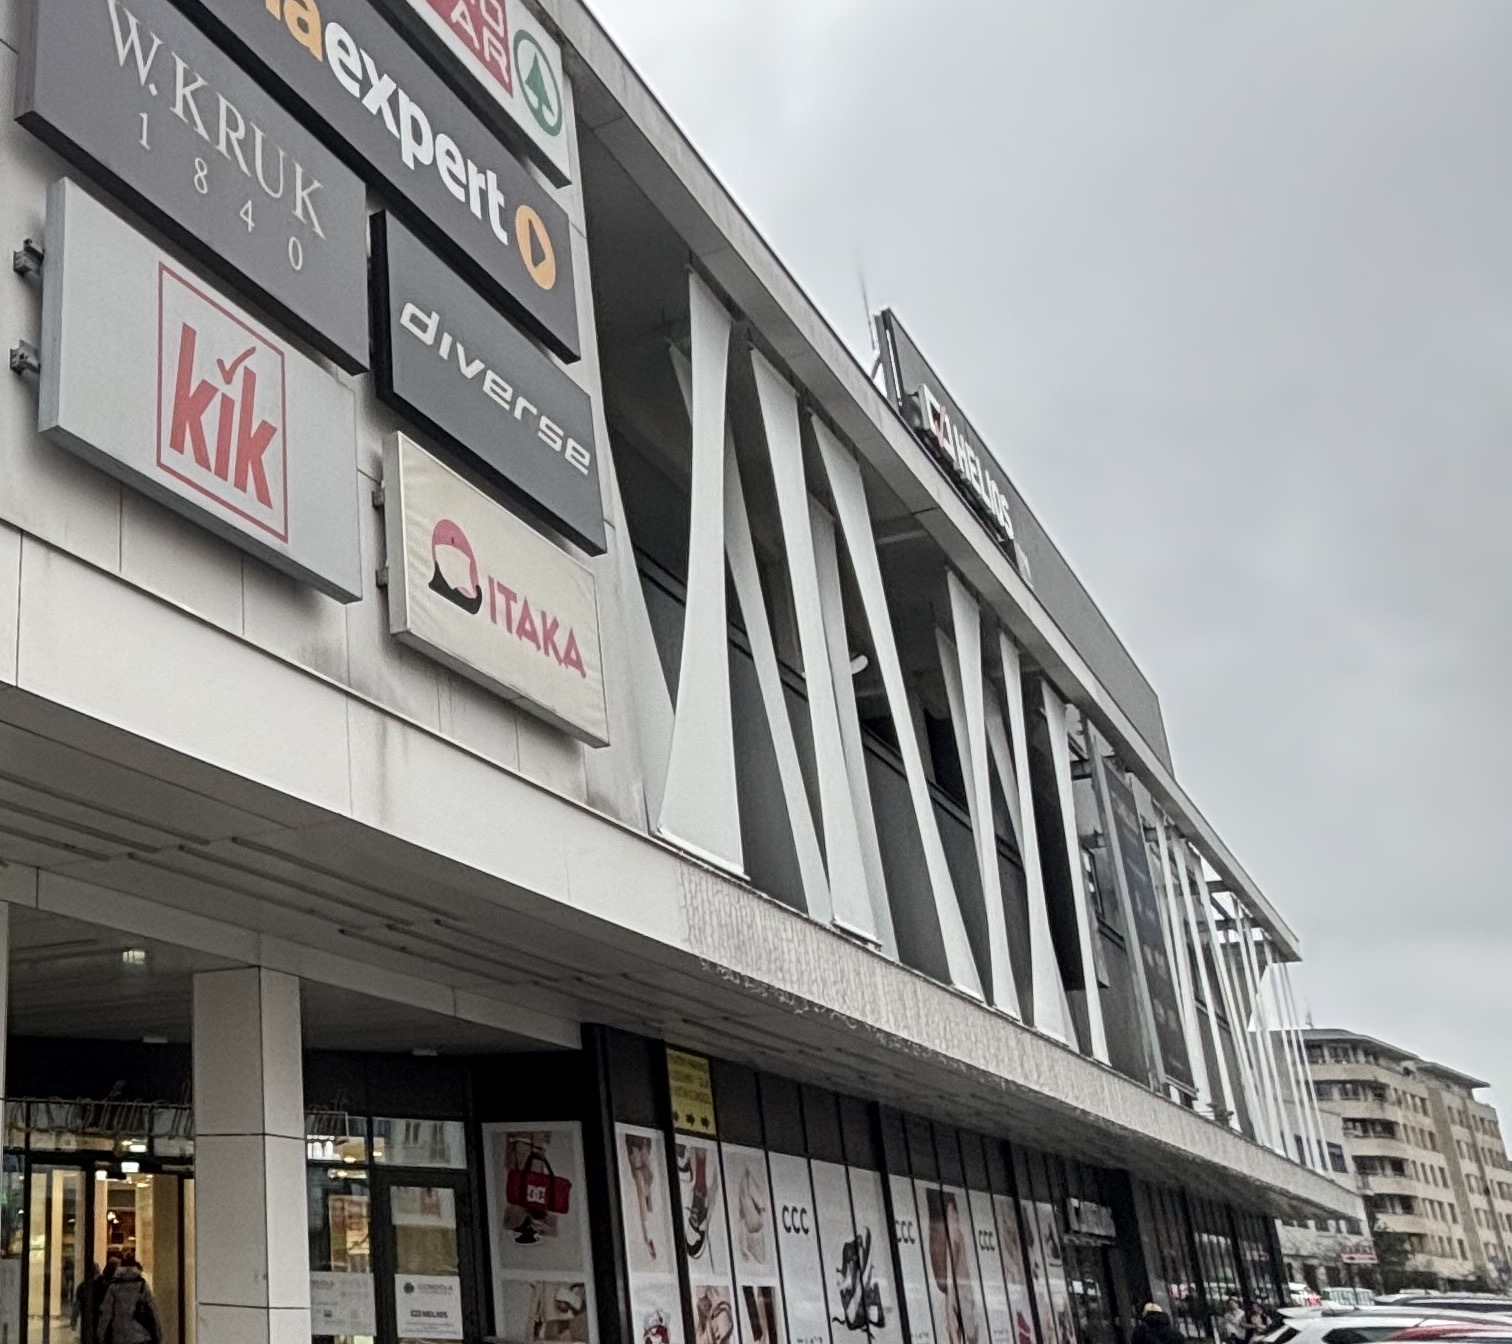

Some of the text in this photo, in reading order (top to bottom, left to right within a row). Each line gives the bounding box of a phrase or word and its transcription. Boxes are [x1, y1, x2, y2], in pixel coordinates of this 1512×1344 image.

[399, 302, 592, 475] diverse
[952, 423, 1015, 541] HELIOS
[487, 575, 587, 680] ITAKA
[781, 1205, 810, 1236] CCC
